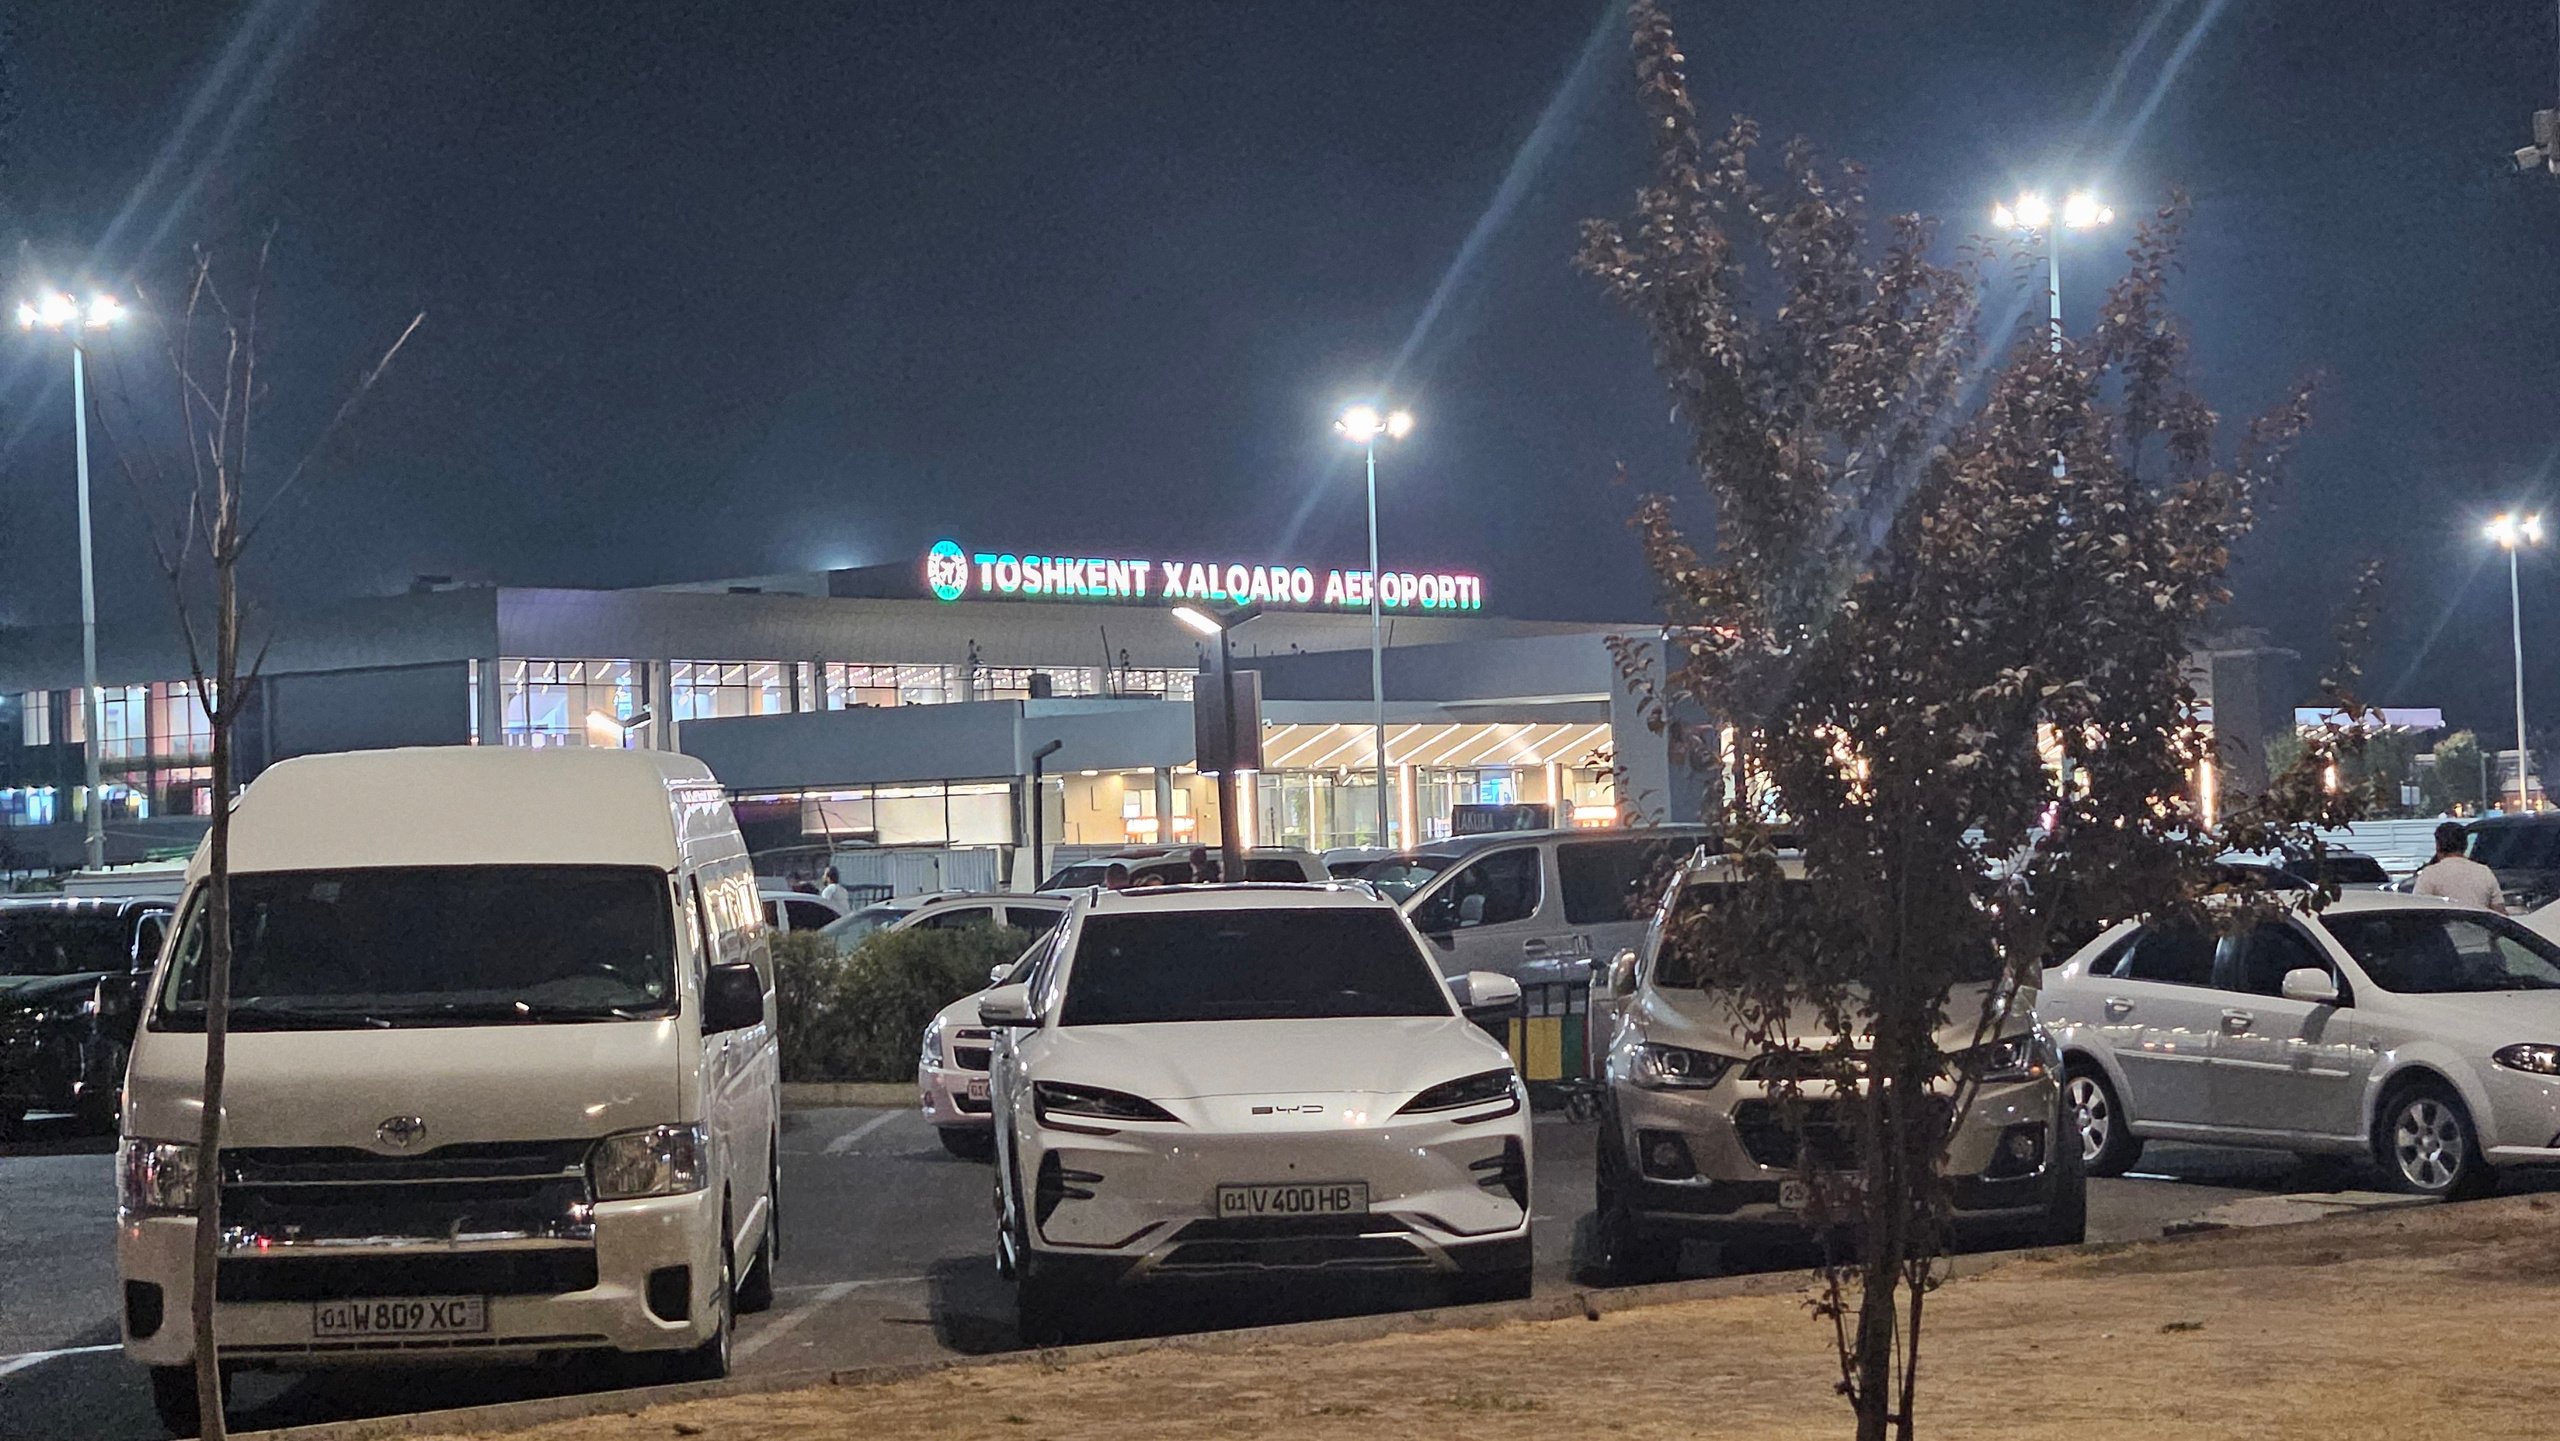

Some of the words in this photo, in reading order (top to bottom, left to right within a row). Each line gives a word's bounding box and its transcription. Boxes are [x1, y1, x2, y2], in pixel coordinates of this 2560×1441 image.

[974, 554, 1150, 596] TOSHKENT
[1162, 562, 1315, 605] XALQARO
[1252, 1105, 1323, 1115] BYD
[1225, 1193, 1246, 1211] 01
